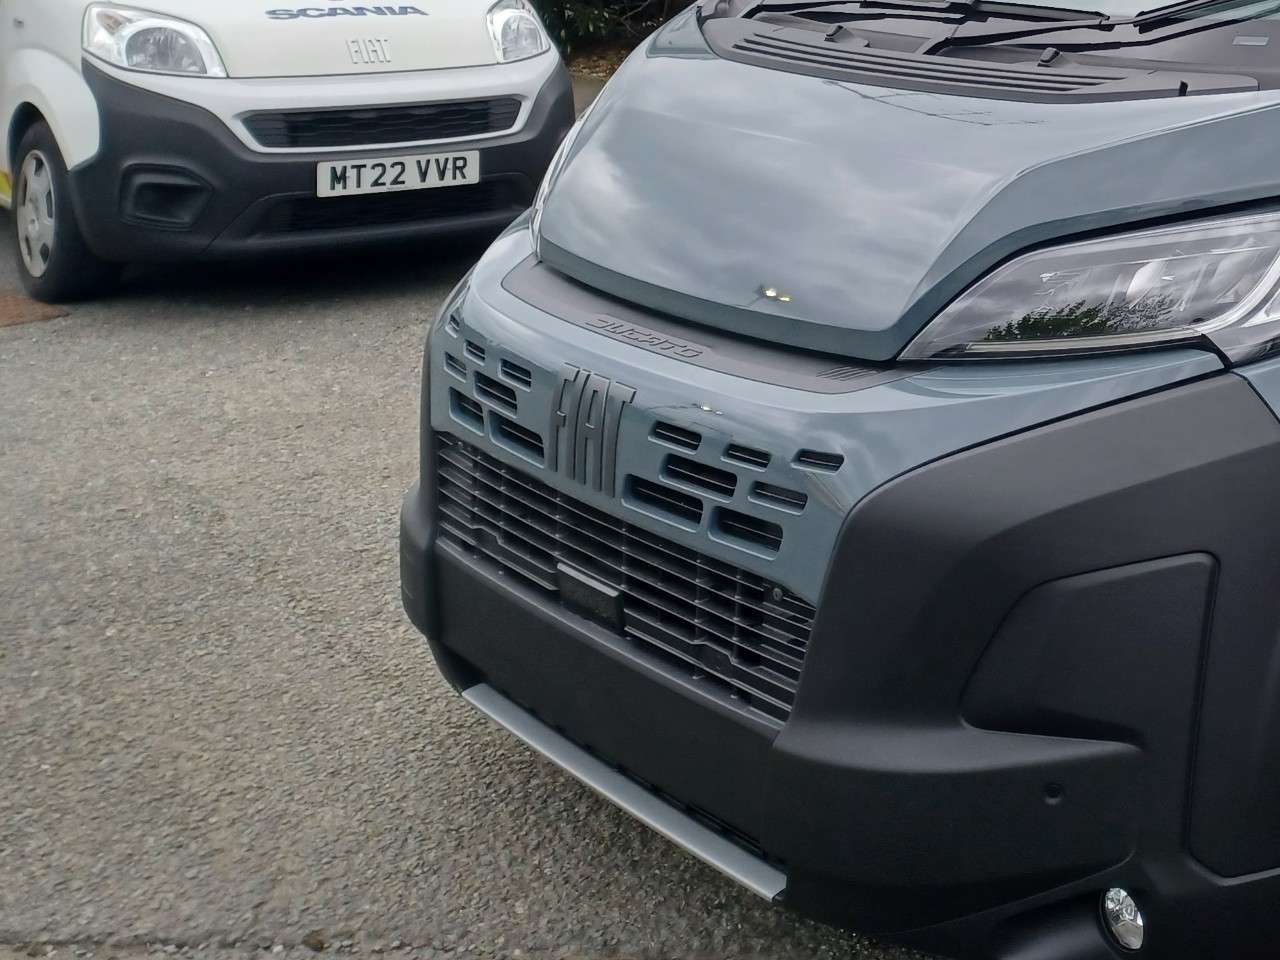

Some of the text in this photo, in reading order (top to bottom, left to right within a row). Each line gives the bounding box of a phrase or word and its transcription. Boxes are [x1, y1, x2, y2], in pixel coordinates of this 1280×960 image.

[265, 5, 430, 20] SCANIA
[346, 39, 392, 65] FIAT
[330, 156, 468, 191] MT22 VVR
[549, 362, 638, 499] FIAT
